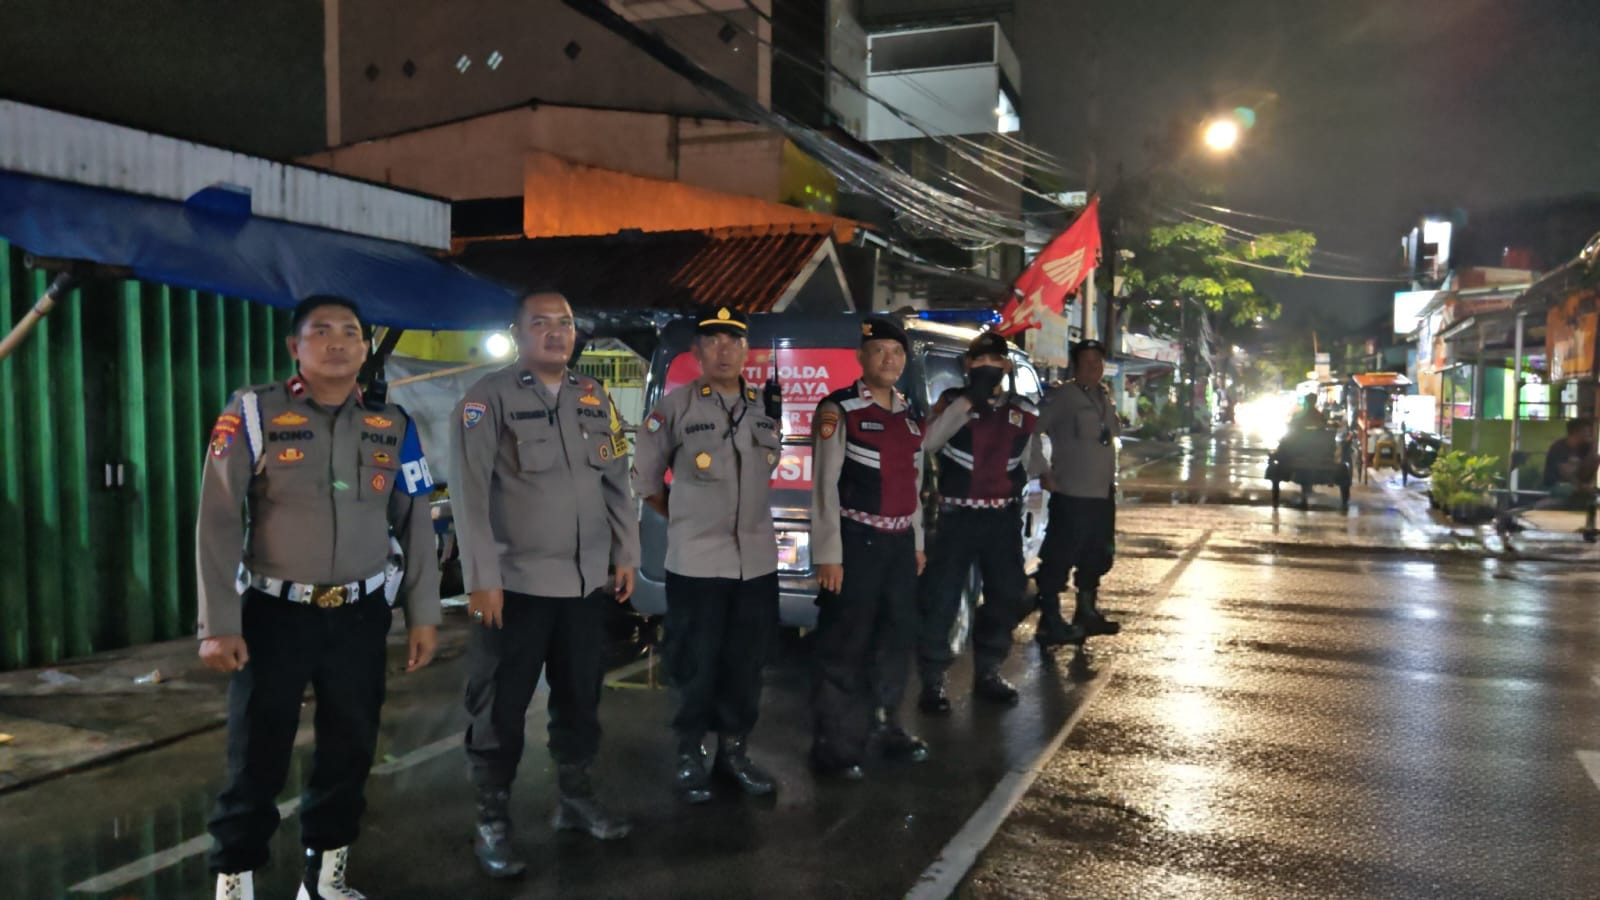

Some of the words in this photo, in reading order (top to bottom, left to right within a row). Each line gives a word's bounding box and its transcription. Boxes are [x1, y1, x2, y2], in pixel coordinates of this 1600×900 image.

[743, 366, 761, 379] TI
[767, 366, 829, 379] POLDA
[577, 407, 607, 419] POLRI
[361, 431, 397, 446] POLRI
